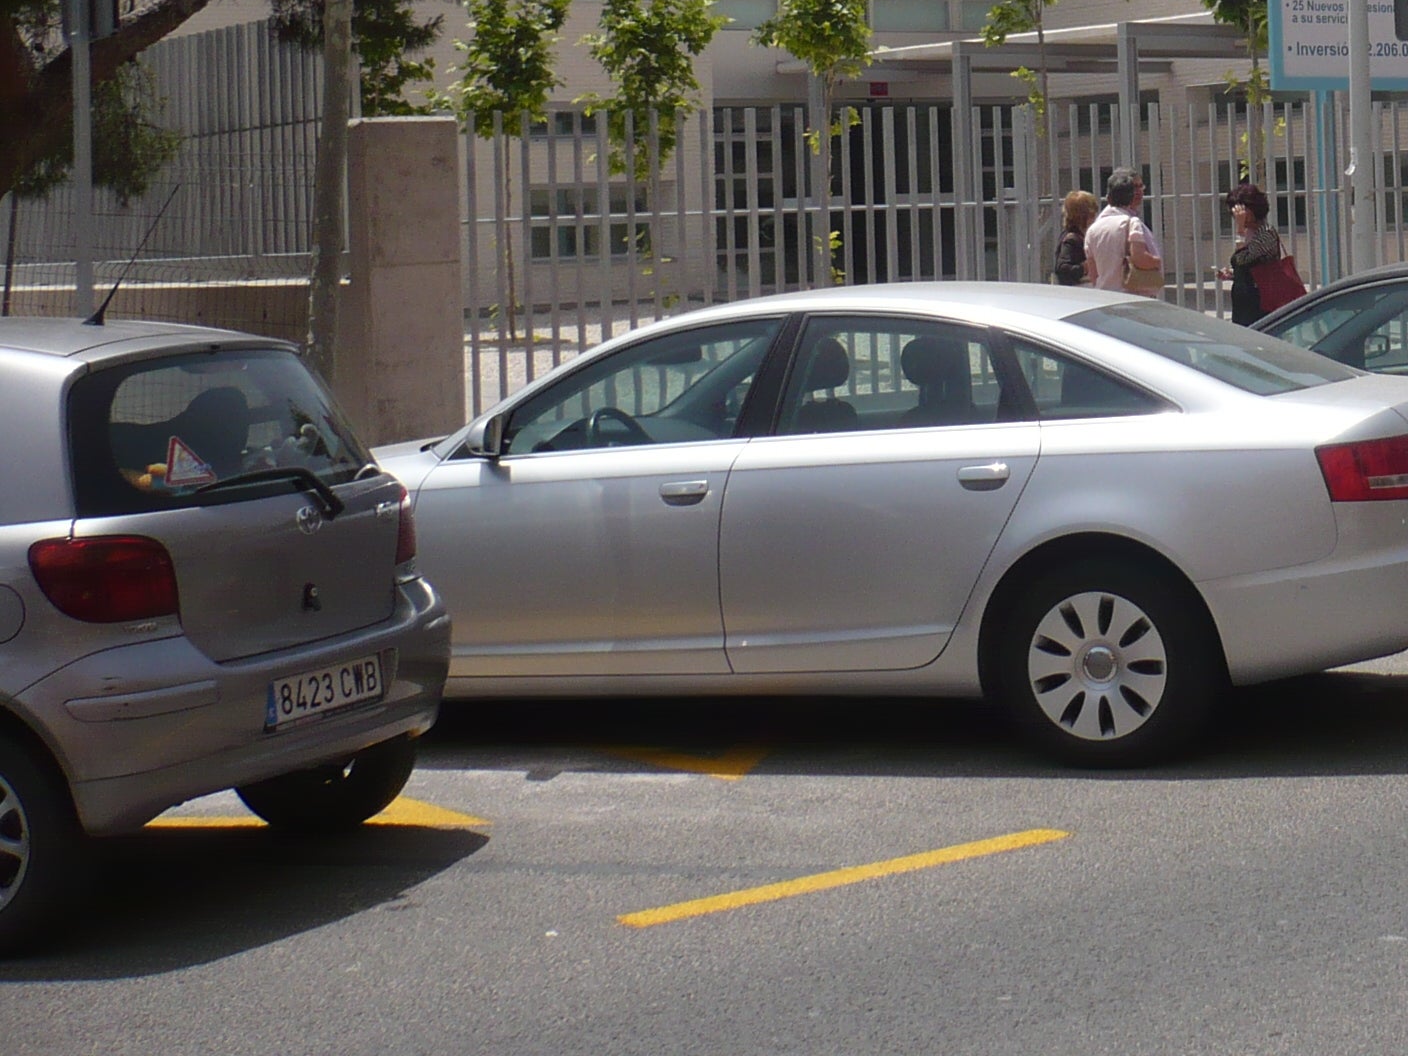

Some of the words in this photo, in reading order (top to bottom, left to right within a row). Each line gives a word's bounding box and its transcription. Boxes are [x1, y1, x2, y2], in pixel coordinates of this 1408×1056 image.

[1292, 0, 1304, 11] 25
[1307, 0, 1345, 12] Nuevos
[1291, 15, 1298, 24] a
[1301, 14, 1313, 24] su
[1315, 13, 1348, 24] servici
[1296, 41, 1350, 57] Inversió
[280, 672, 335, 716] 8423
